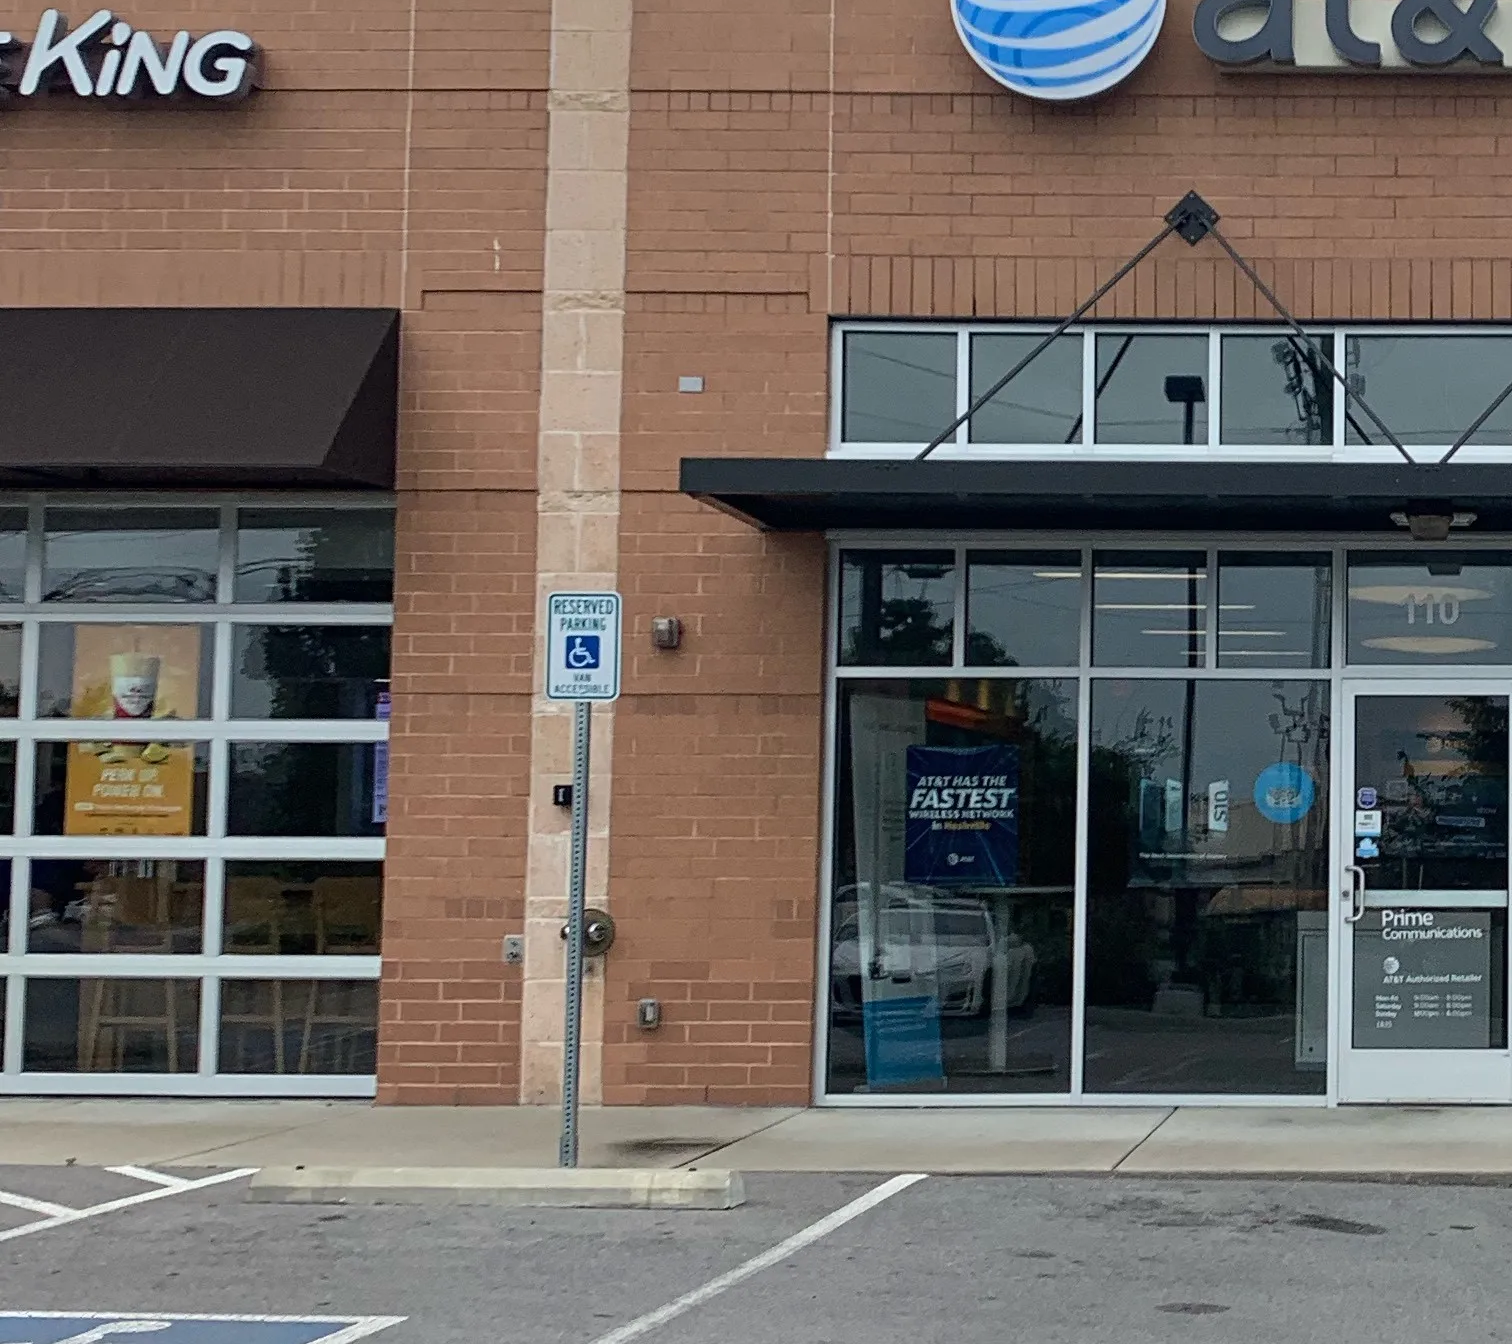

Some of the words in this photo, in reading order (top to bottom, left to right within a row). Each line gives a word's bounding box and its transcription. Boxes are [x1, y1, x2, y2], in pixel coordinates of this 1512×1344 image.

[554, 599, 614, 614] RESERVED
[1402, 593, 1459, 624] 110
[560, 617, 607, 631] PARKING
[573, 673, 592, 682] VAN
[554, 683, 610, 694] ACCESSIBLE
[917, 775, 951, 787] AT&T
[952, 775, 980, 787] HAS
[982, 775, 1008, 787] THE
[909, 787, 1017, 809] FASTEST
[909, 809, 960, 819] WIRELESS
[961, 808, 1015, 819] NETWORK
[1382, 909, 1434, 926] Prime
[1382, 926, 1483, 940] Communications
[1383, 975, 1404, 984] AT&T
[1405, 974, 1450, 984] Authorized
[1451, 974, 1482, 984] Retailer
[1375, 1002, 1402, 1011] Saturday
[1375, 1010, 1398, 1018] Sunday
